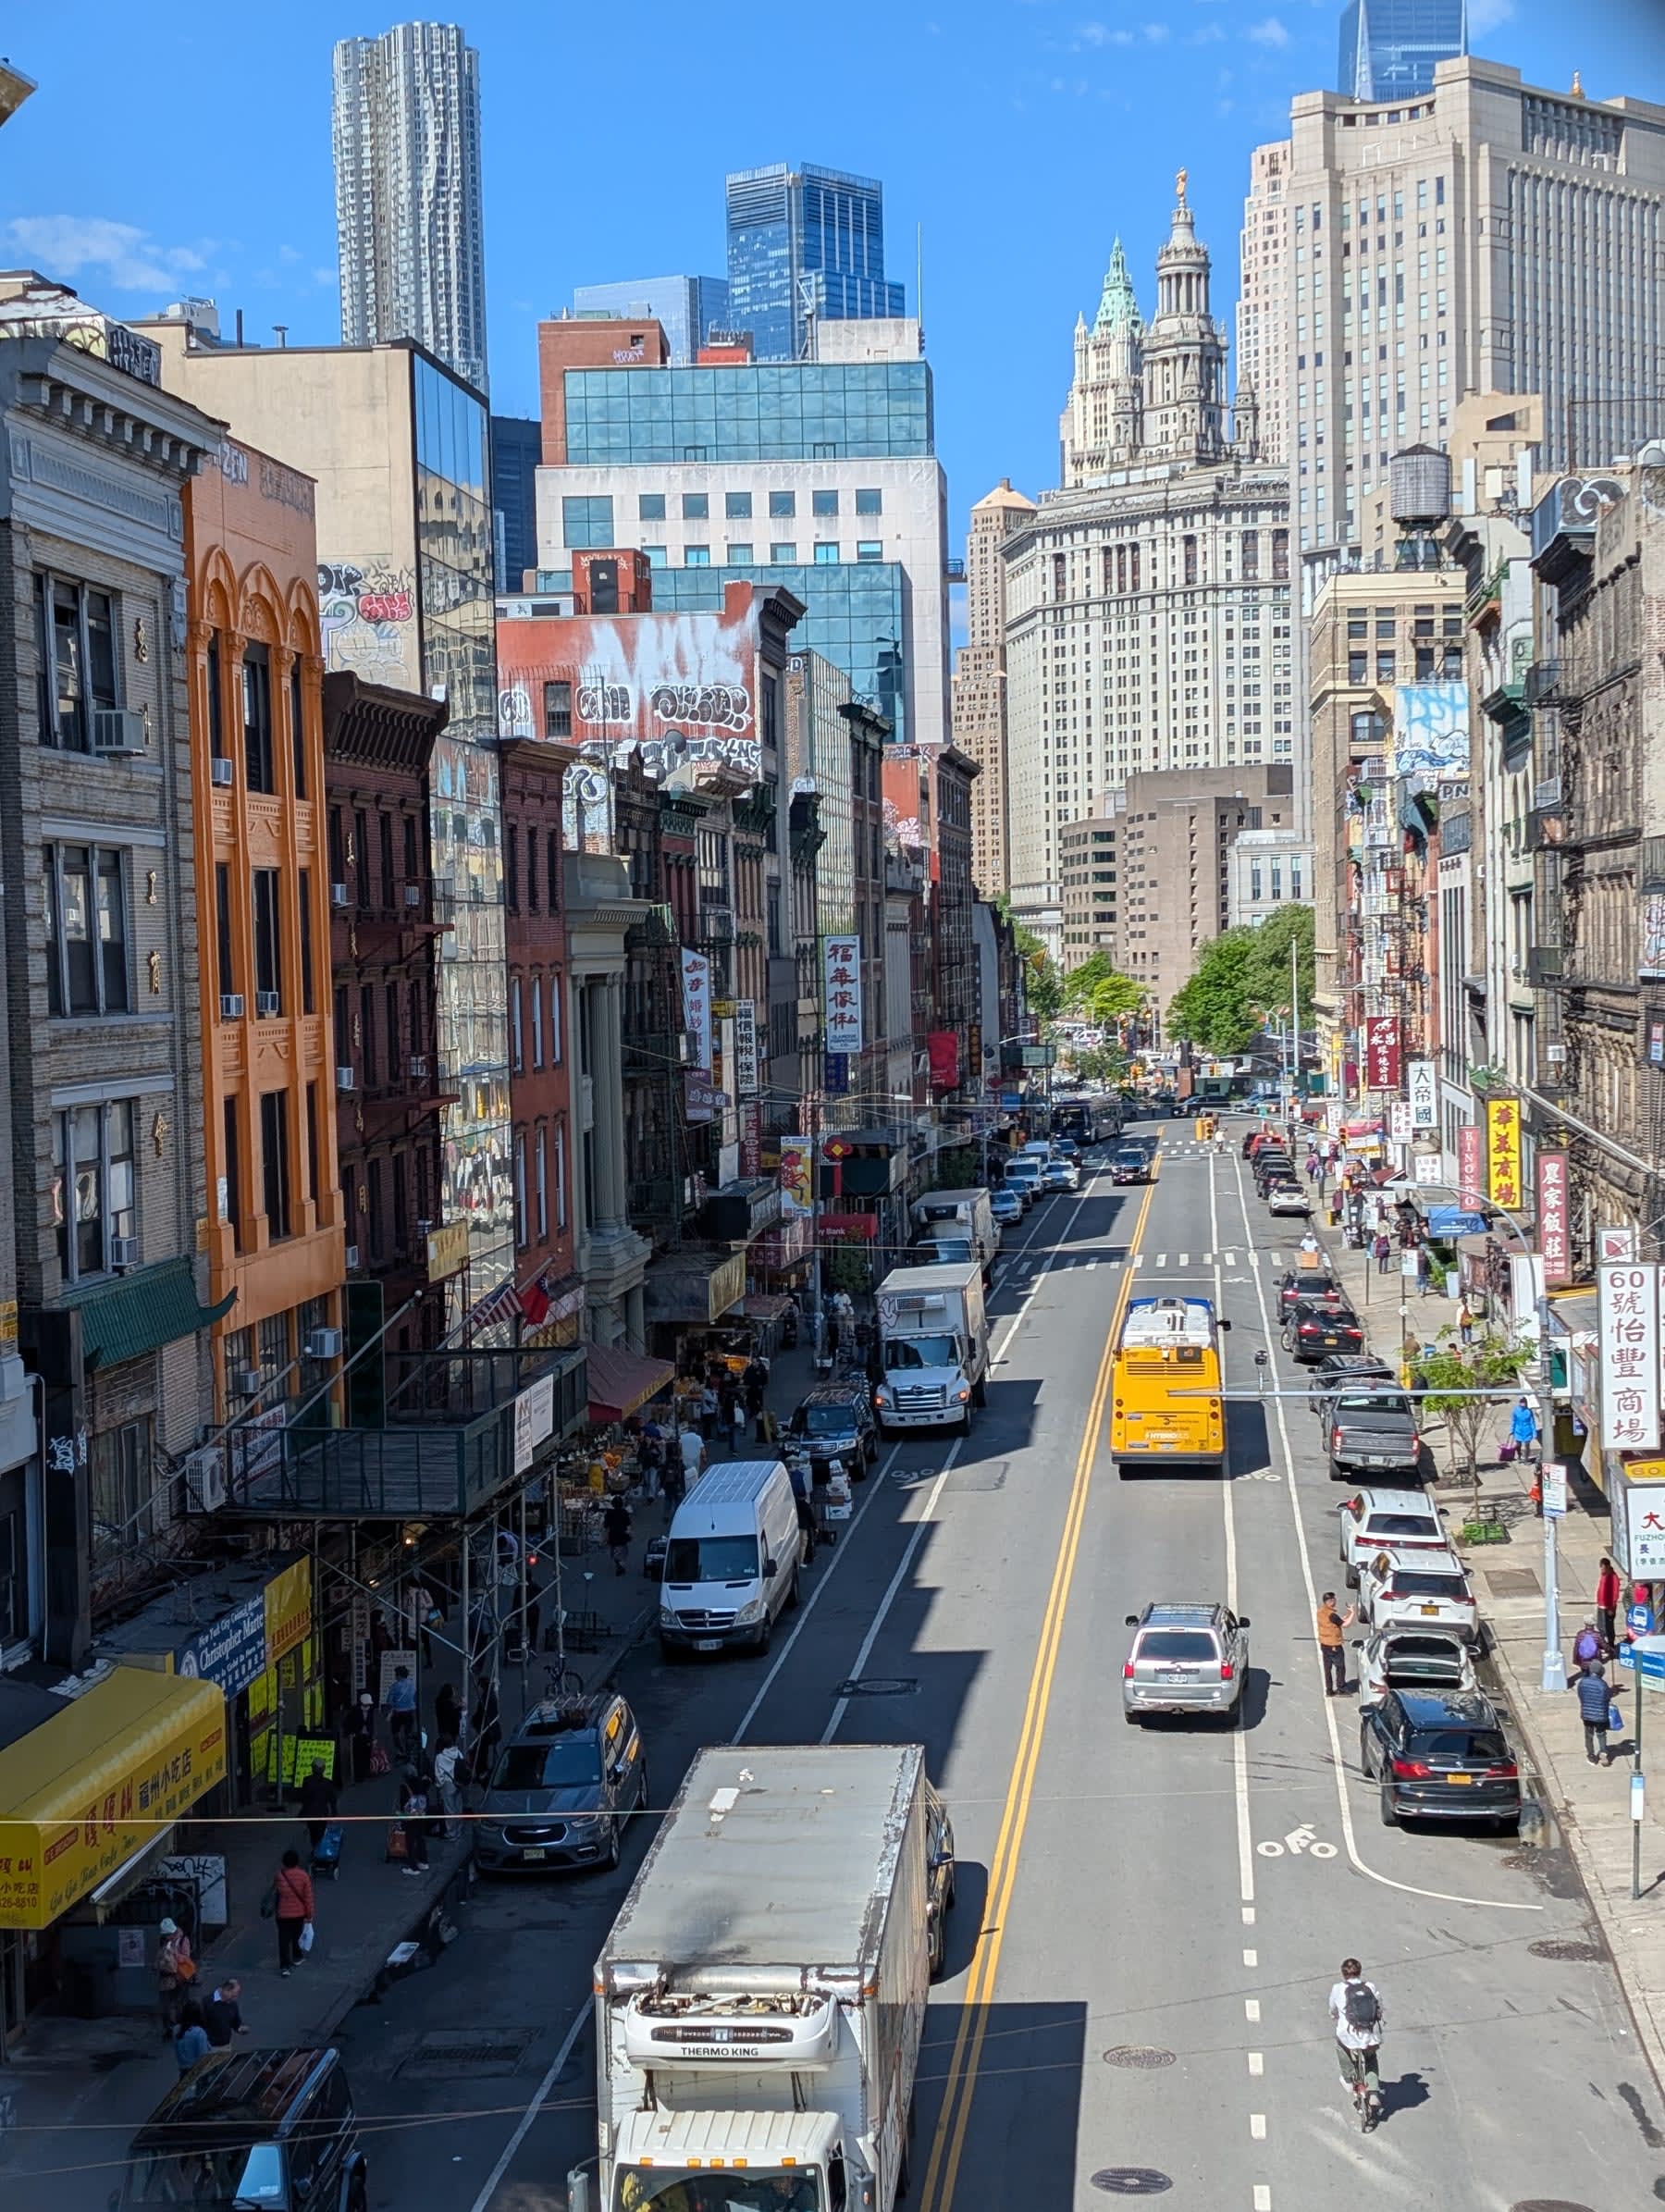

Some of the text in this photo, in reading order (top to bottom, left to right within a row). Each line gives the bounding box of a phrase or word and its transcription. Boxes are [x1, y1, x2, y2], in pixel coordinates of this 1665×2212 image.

[828, 944, 857, 1030] 福華傢俬
[1413, 1067, 1432, 1124] 大帝國
[1464, 1131, 1474, 1205] BINONDO
[1492, 1105, 1517, 1205] 華美商場
[826, 1227, 845, 1235] Bank
[1542, 1162, 1565, 1259] 農家飯莊
[1610, 1271, 1645, 1288] 60
[1610, 1291, 1648, 1443] 號怡豐商場
[200, 1629, 241, 1671] Christopher
[242, 1613, 264, 1640] Marte
[681, 2046, 758, 2057] THERMO KING
